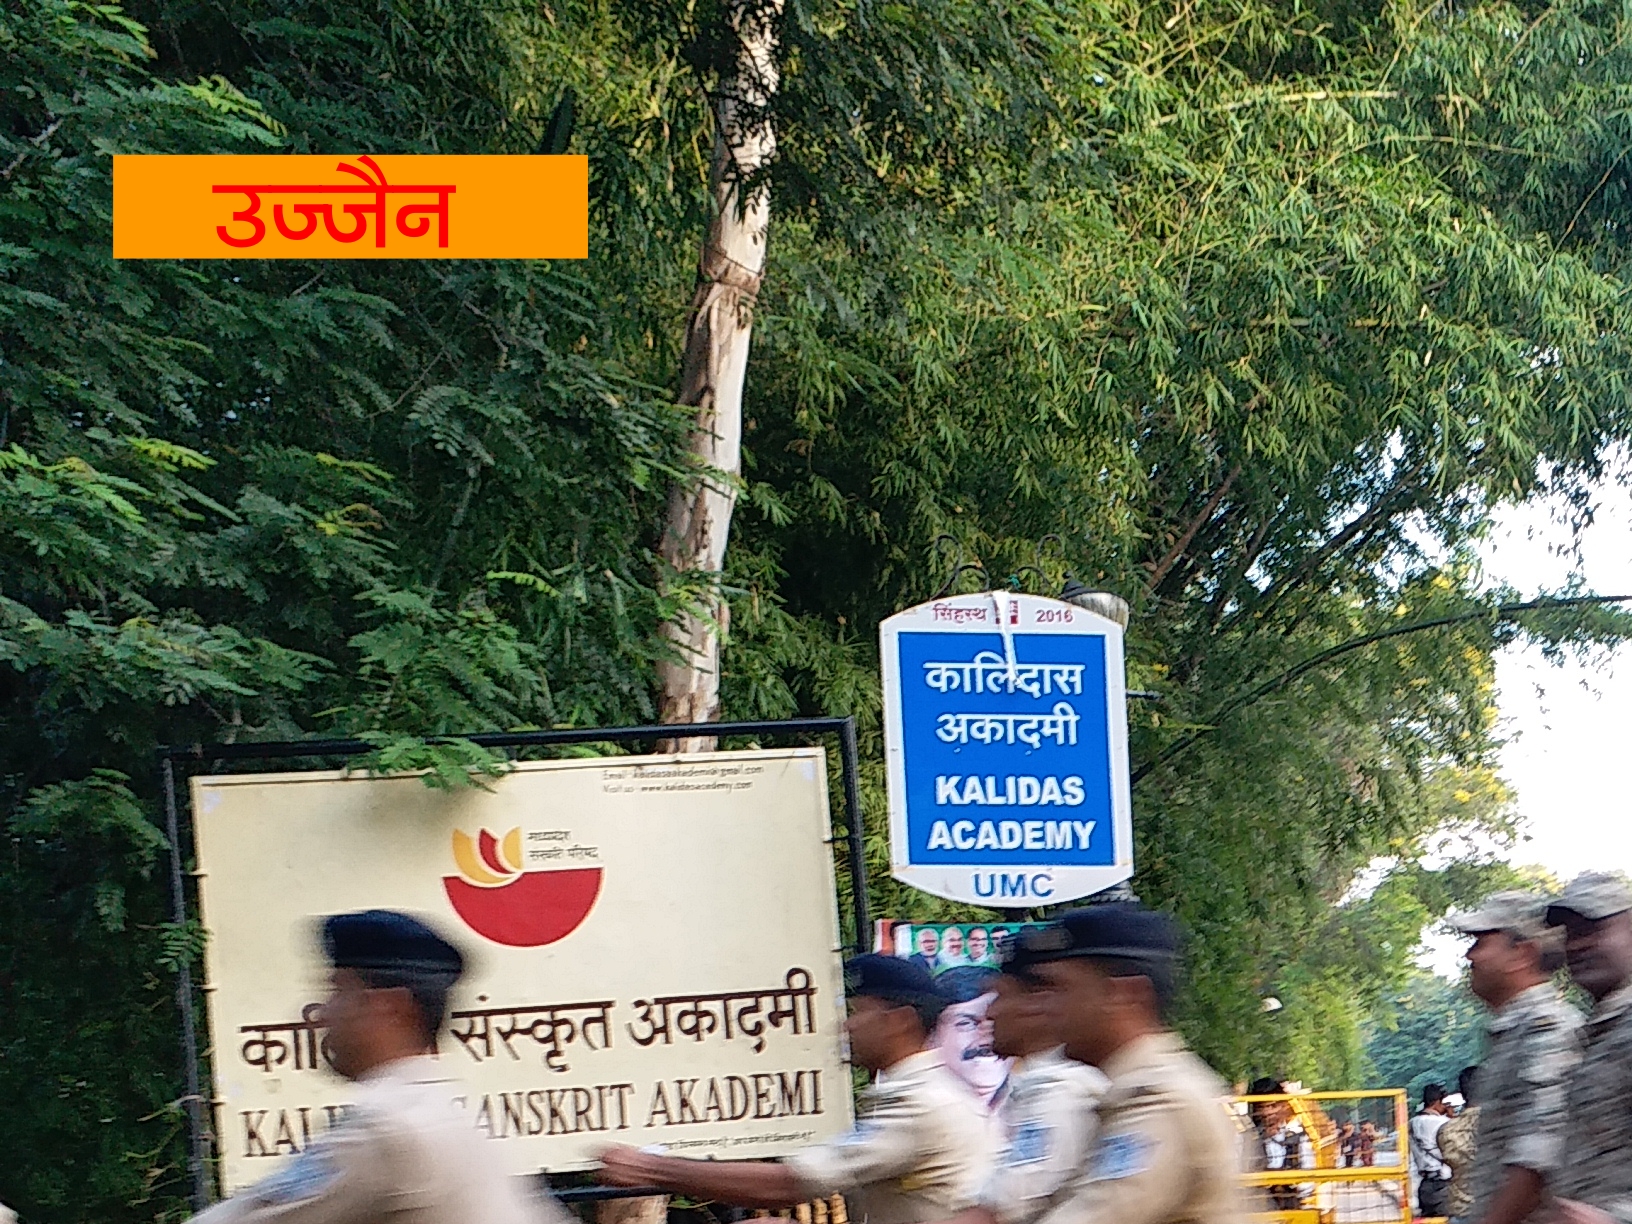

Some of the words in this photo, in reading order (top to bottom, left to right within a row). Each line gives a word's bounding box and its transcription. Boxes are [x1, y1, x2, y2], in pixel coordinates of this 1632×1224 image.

[932, 602, 988, 623] सिंहस्थ
[922, 650, 1087, 699] कालिदास
[934, 701, 1082, 750] अकादमी
[934, 774, 1087, 807] KALIDAS
[926, 819, 1098, 851] ACADEMY
[972, 871, 1056, 898] UMC
[450, 994, 617, 1072] संस्कृत
[627, 968, 819, 1055] अकादमी
[644, 1070, 824, 1127] AKADEMI
